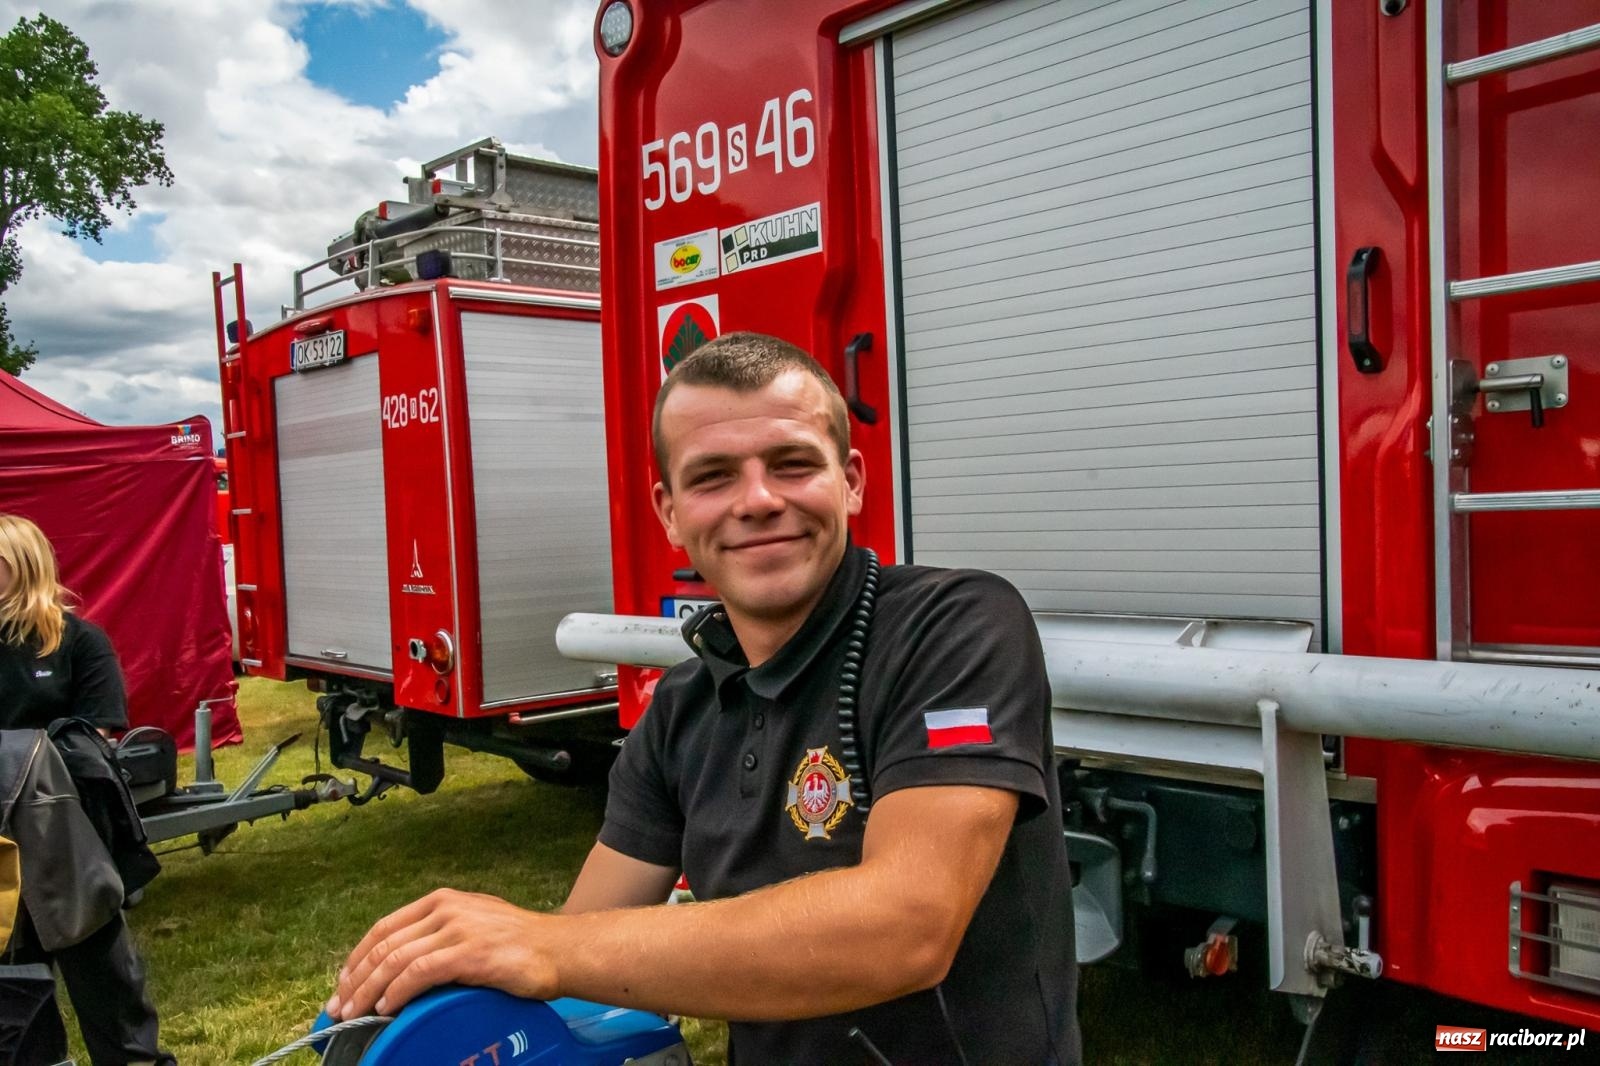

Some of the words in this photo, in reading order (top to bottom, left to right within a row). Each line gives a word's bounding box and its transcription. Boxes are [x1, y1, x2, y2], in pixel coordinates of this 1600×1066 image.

[642, 121, 721, 211] 569
[730, 129, 745, 168] S
[755, 88, 815, 174] 46
[749, 207, 818, 248] KUHN
[743, 247, 768, 263] PRD
[298, 342, 310, 364] OK
[313, 335, 342, 361] 53122
[383, 393, 408, 429] 428
[419, 387, 439, 424] 62
